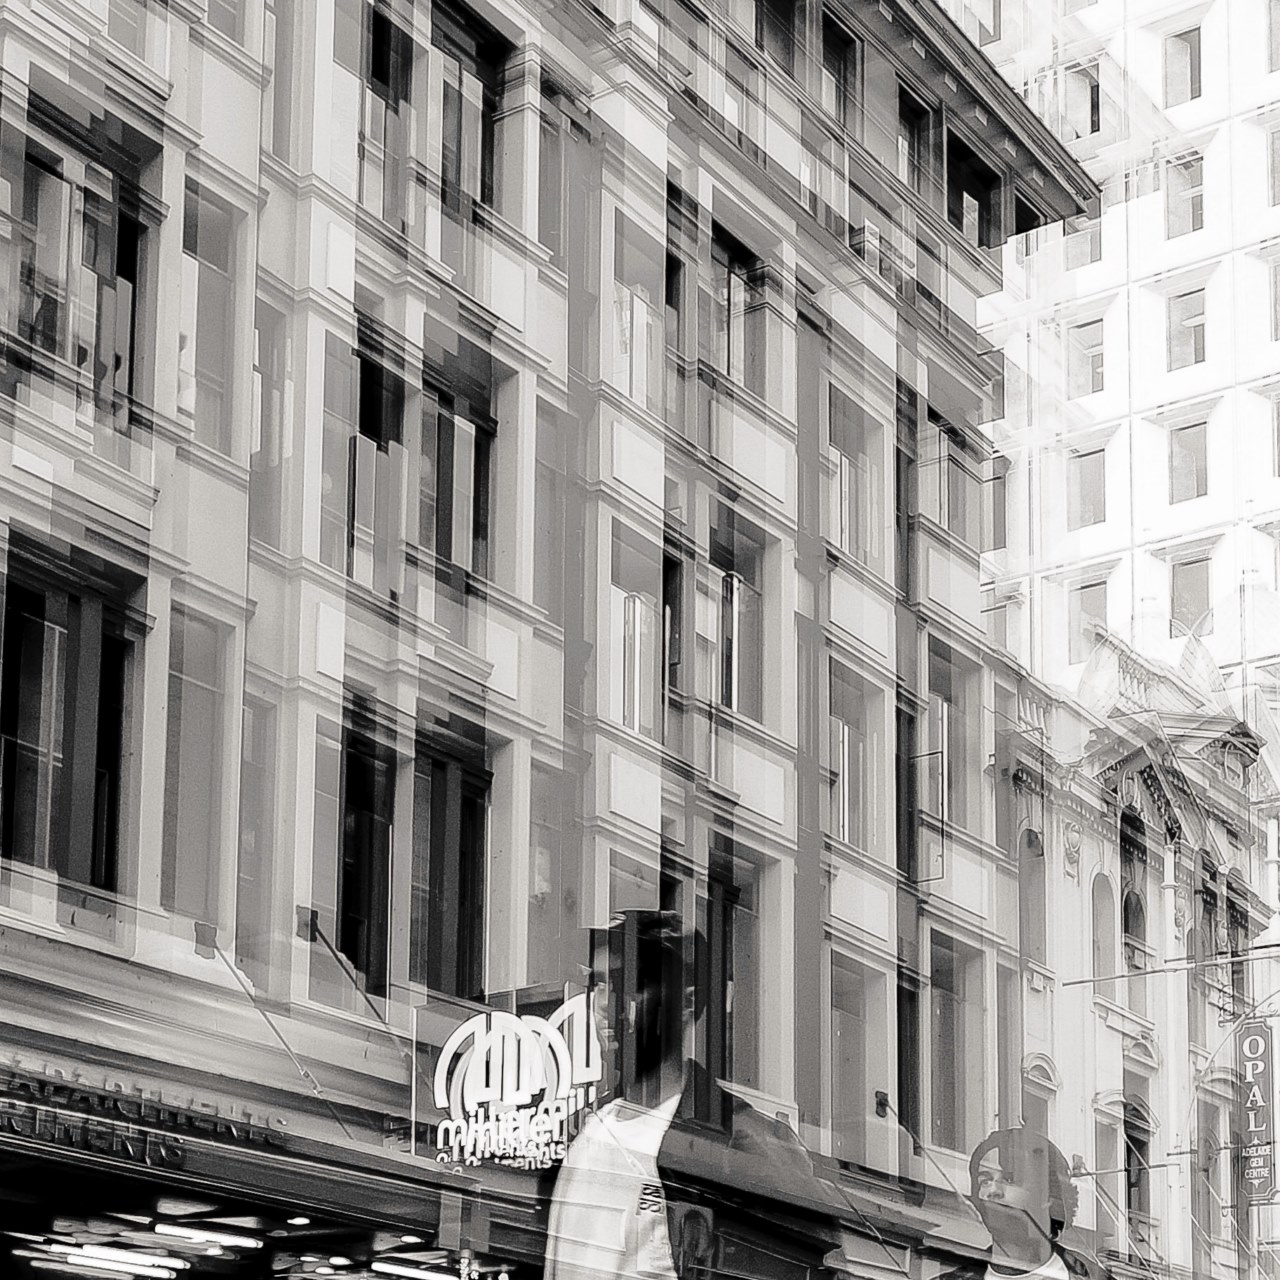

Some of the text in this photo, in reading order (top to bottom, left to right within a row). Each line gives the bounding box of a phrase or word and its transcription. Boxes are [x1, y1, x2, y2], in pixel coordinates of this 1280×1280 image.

[1241, 1035, 1267, 1132] OPAL
[1242, 1146, 1272, 1157] ADELAIDE
[1249, 1157, 1264, 1167] GEM
[1244, 1167, 1270, 1179] CENTRE
